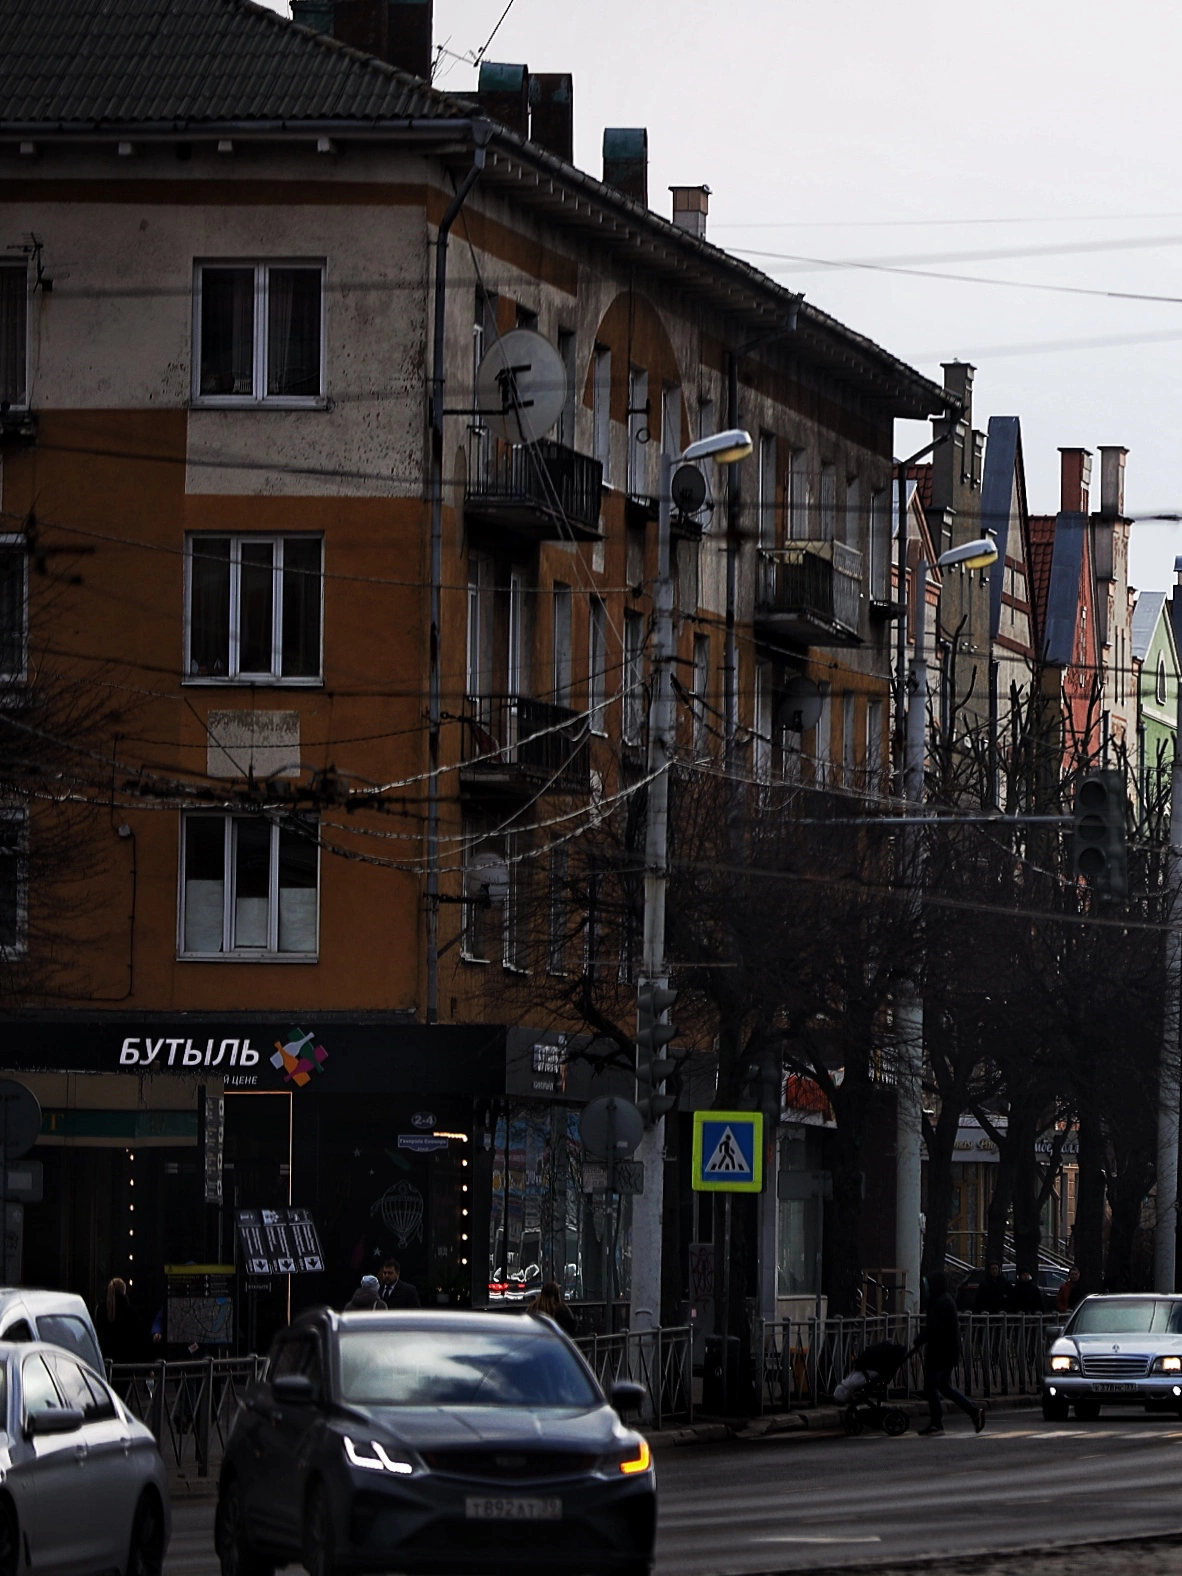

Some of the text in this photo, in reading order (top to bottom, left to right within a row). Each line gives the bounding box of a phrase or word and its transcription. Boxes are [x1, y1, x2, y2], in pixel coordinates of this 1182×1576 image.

[119, 1037, 260, 1067] БУТЫЛЬ
[232, 1075, 258, 1086] ЦЕНЕ
[414, 1115, 434, 1125] 2-4
